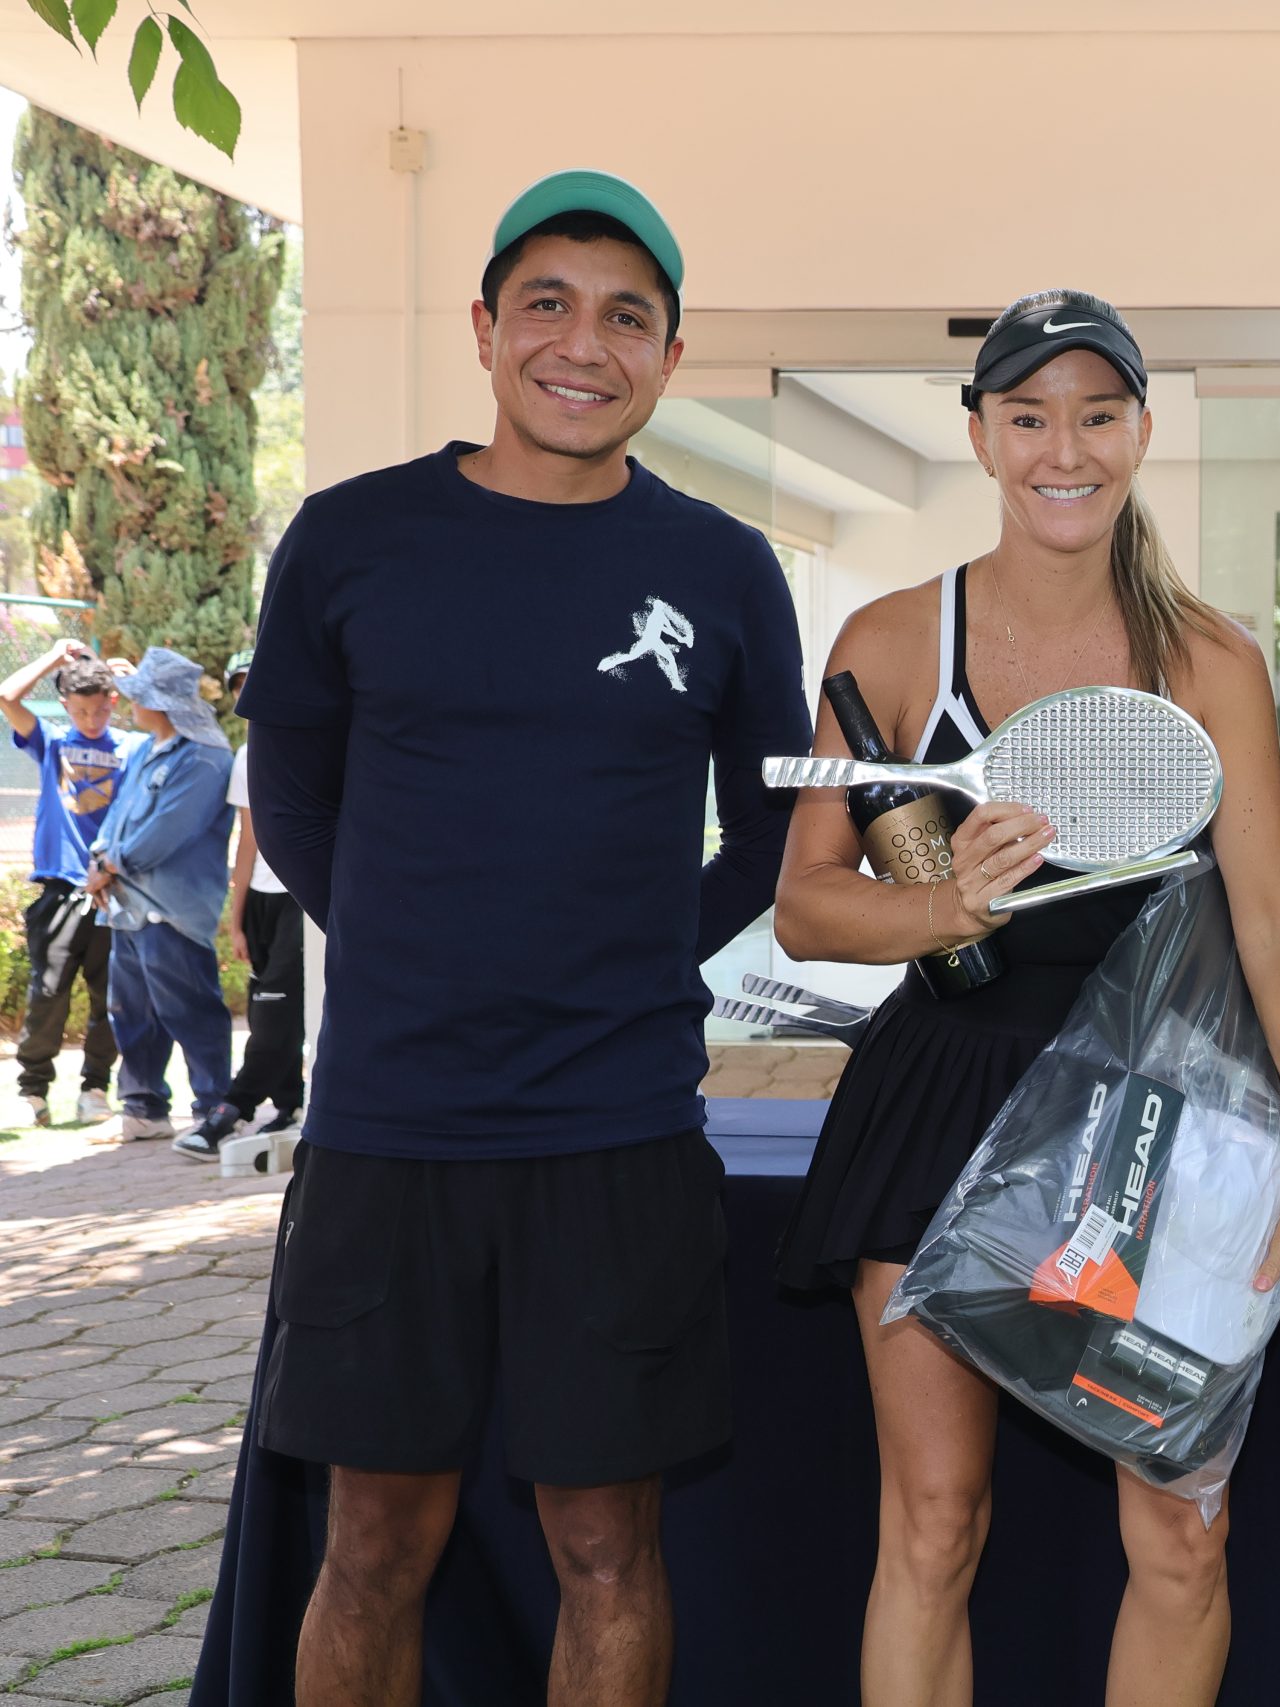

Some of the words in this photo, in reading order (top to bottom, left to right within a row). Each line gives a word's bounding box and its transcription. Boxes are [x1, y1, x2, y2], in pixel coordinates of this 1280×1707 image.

[1063, 1083, 1108, 1221] HEAD
[1116, 1094, 1162, 1235] HEAD
[1136, 1180, 1157, 1240] MARATHON
